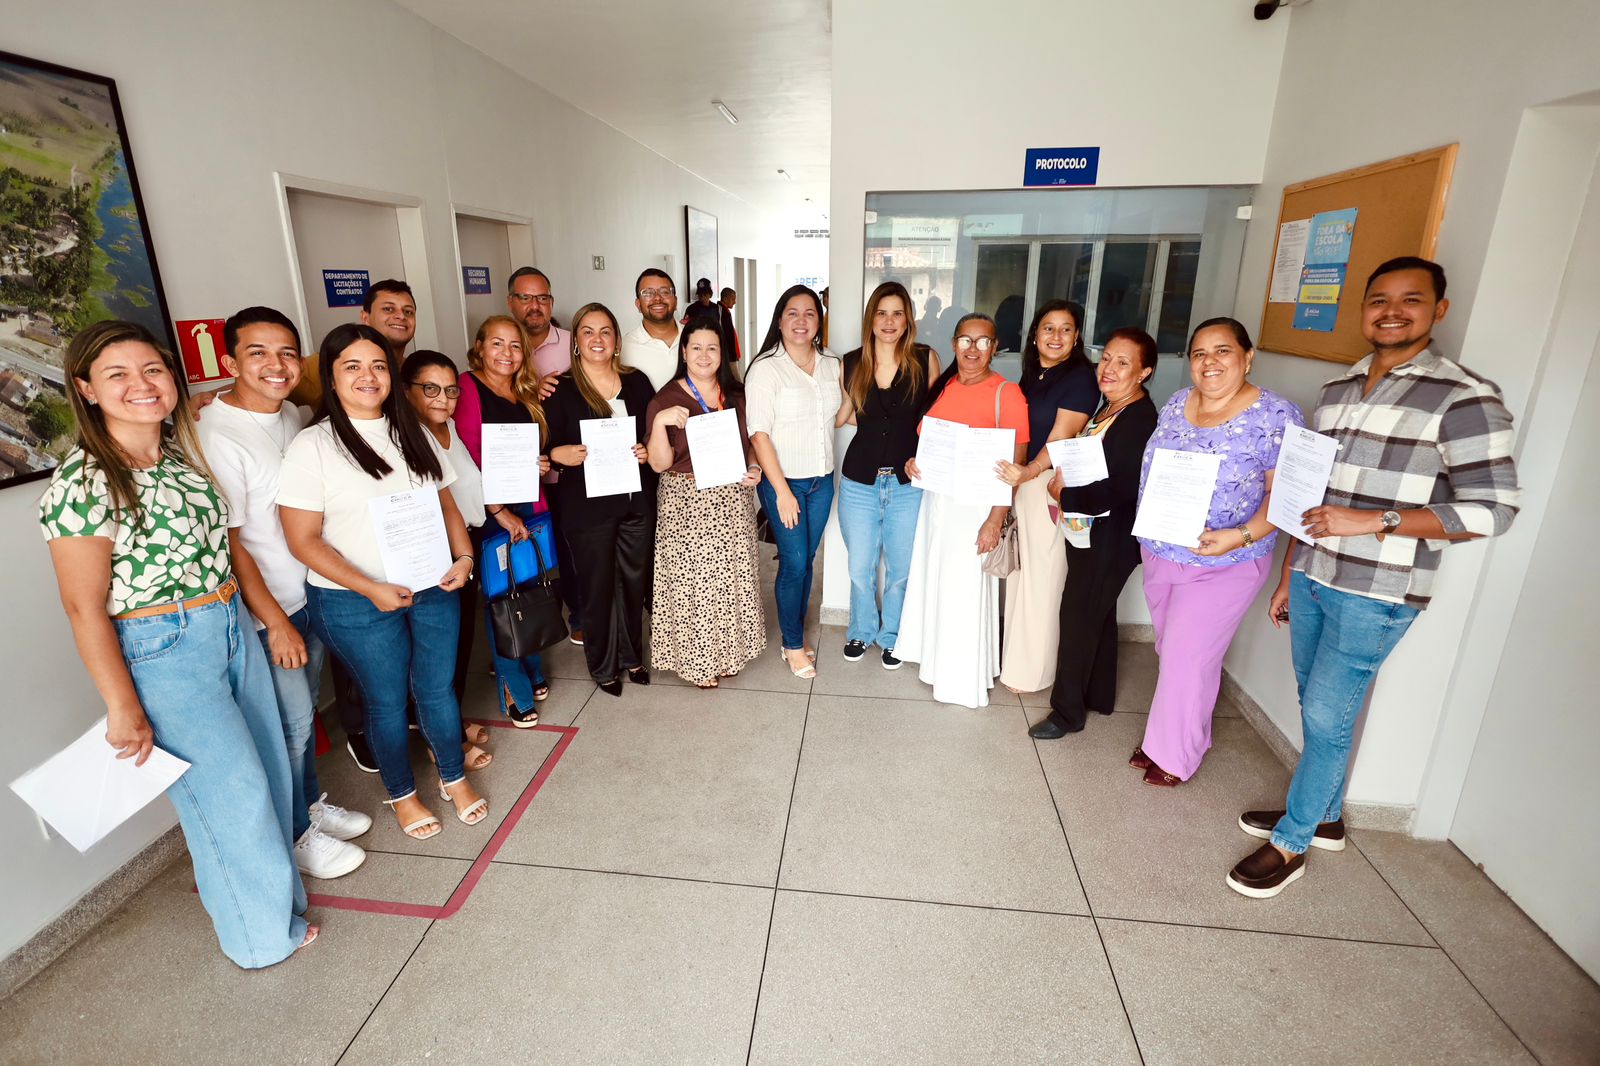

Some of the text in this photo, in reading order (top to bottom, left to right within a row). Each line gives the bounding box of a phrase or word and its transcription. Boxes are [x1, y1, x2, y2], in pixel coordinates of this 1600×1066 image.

[1035, 157, 1087, 170] PROTOCOLO
[911, 224, 940, 234] ATENÇÃO
[1315, 234, 1344, 246] ESCOLA
[324, 272, 361, 280] DEPARTAMENTO
[333, 280, 359, 289] LICITAÇÕES
